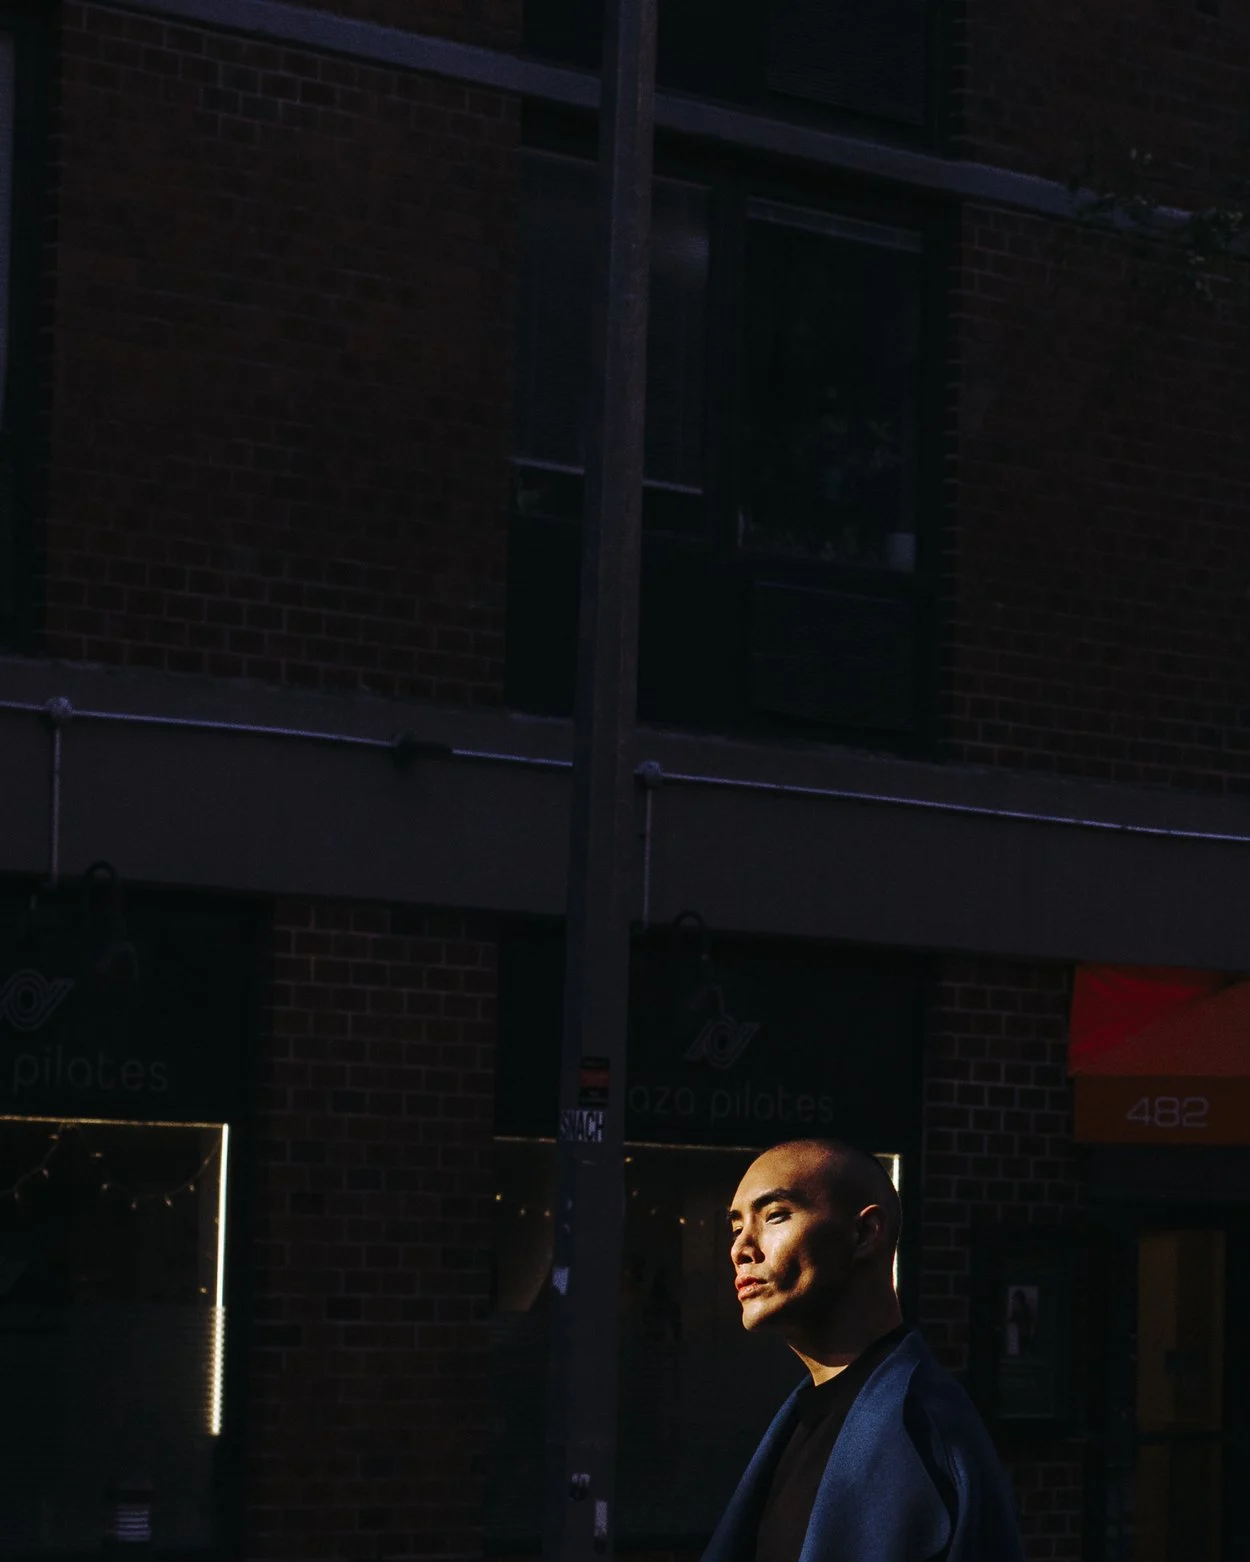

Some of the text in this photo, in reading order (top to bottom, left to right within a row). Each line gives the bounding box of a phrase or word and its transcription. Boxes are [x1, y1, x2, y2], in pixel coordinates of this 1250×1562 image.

[13, 1043, 168, 1098] pilates
[710, 1079, 834, 1128] pilates
[1124, 1096, 1209, 1128] 482
